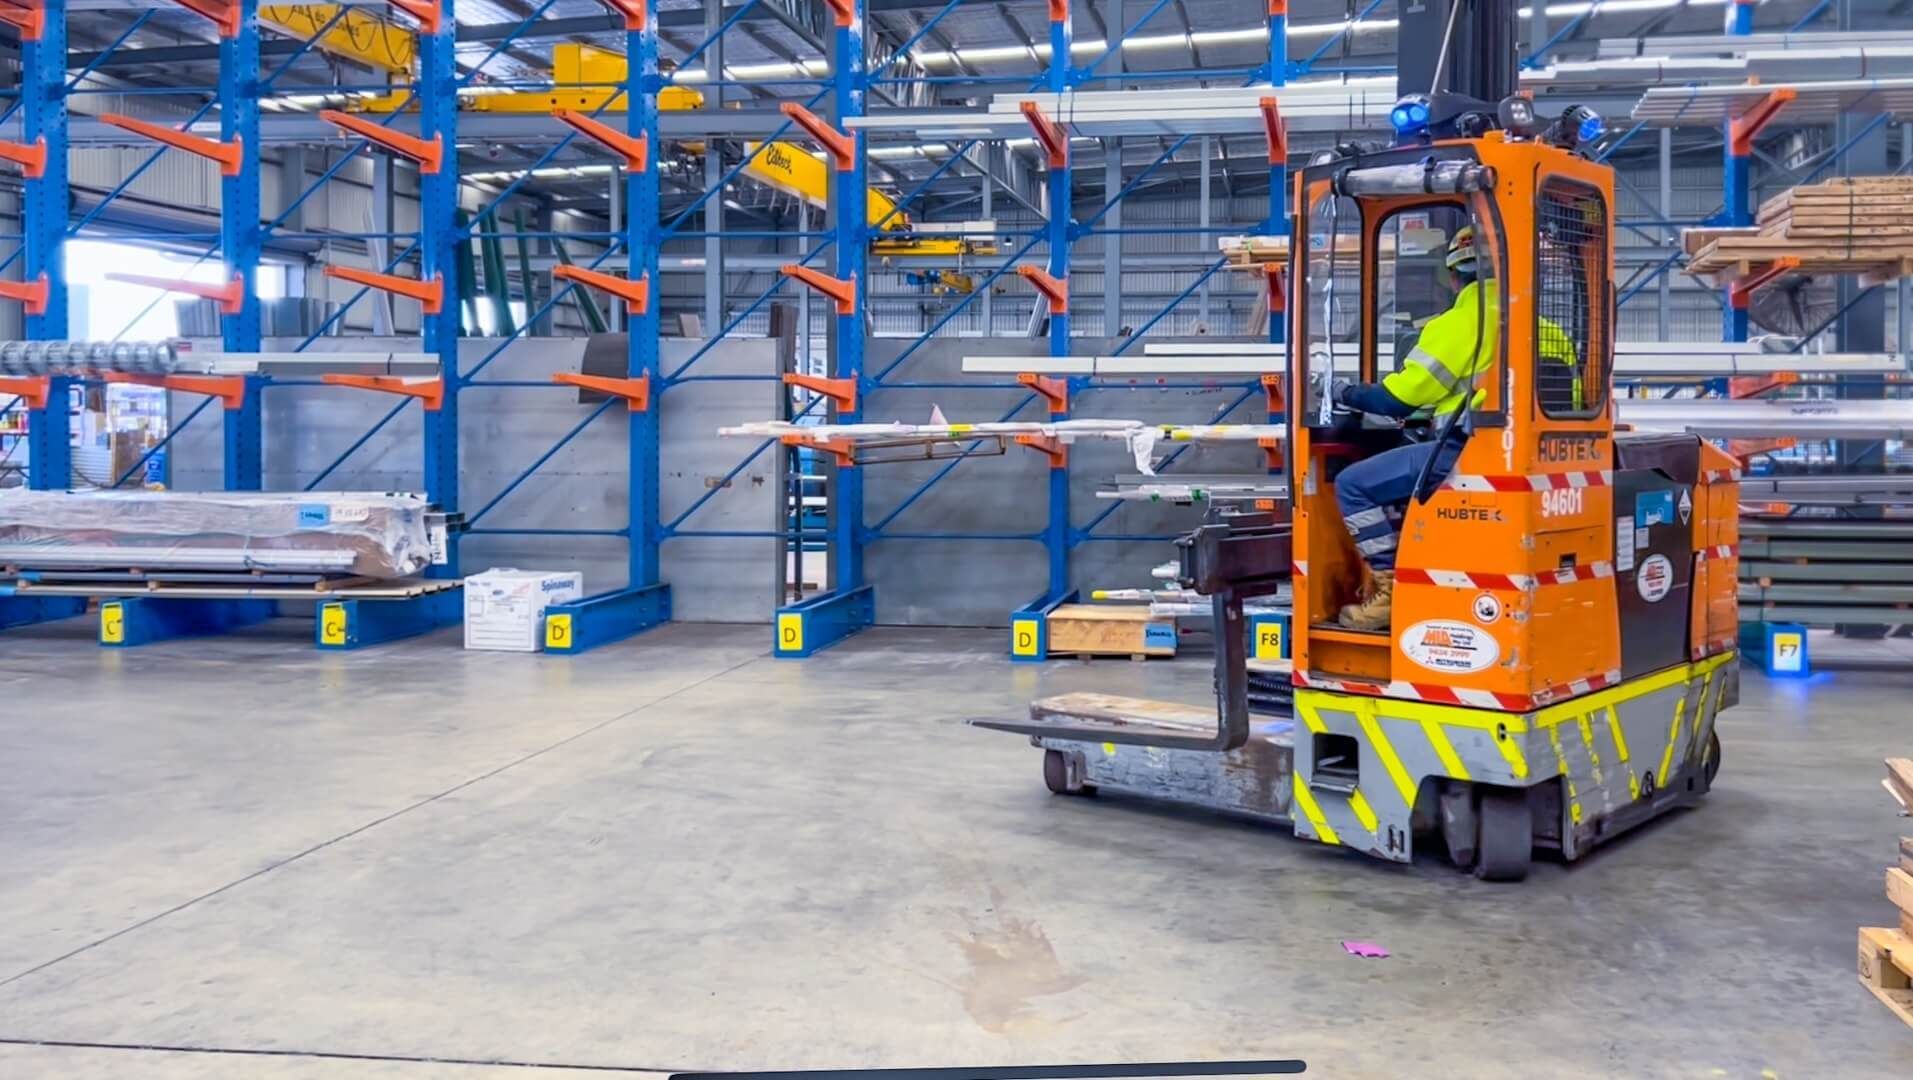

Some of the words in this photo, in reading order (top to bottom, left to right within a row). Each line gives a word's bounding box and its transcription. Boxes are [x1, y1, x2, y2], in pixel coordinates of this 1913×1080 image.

[1542, 488, 1583, 517] 94601
[541, 579, 575, 593] Spinaway
[552, 625, 564, 641] D
[784, 627, 796, 643] D
[1019, 632, 1032, 648] D
[1261, 633, 1279, 646] F8
[1780, 644, 1798, 657] F7
